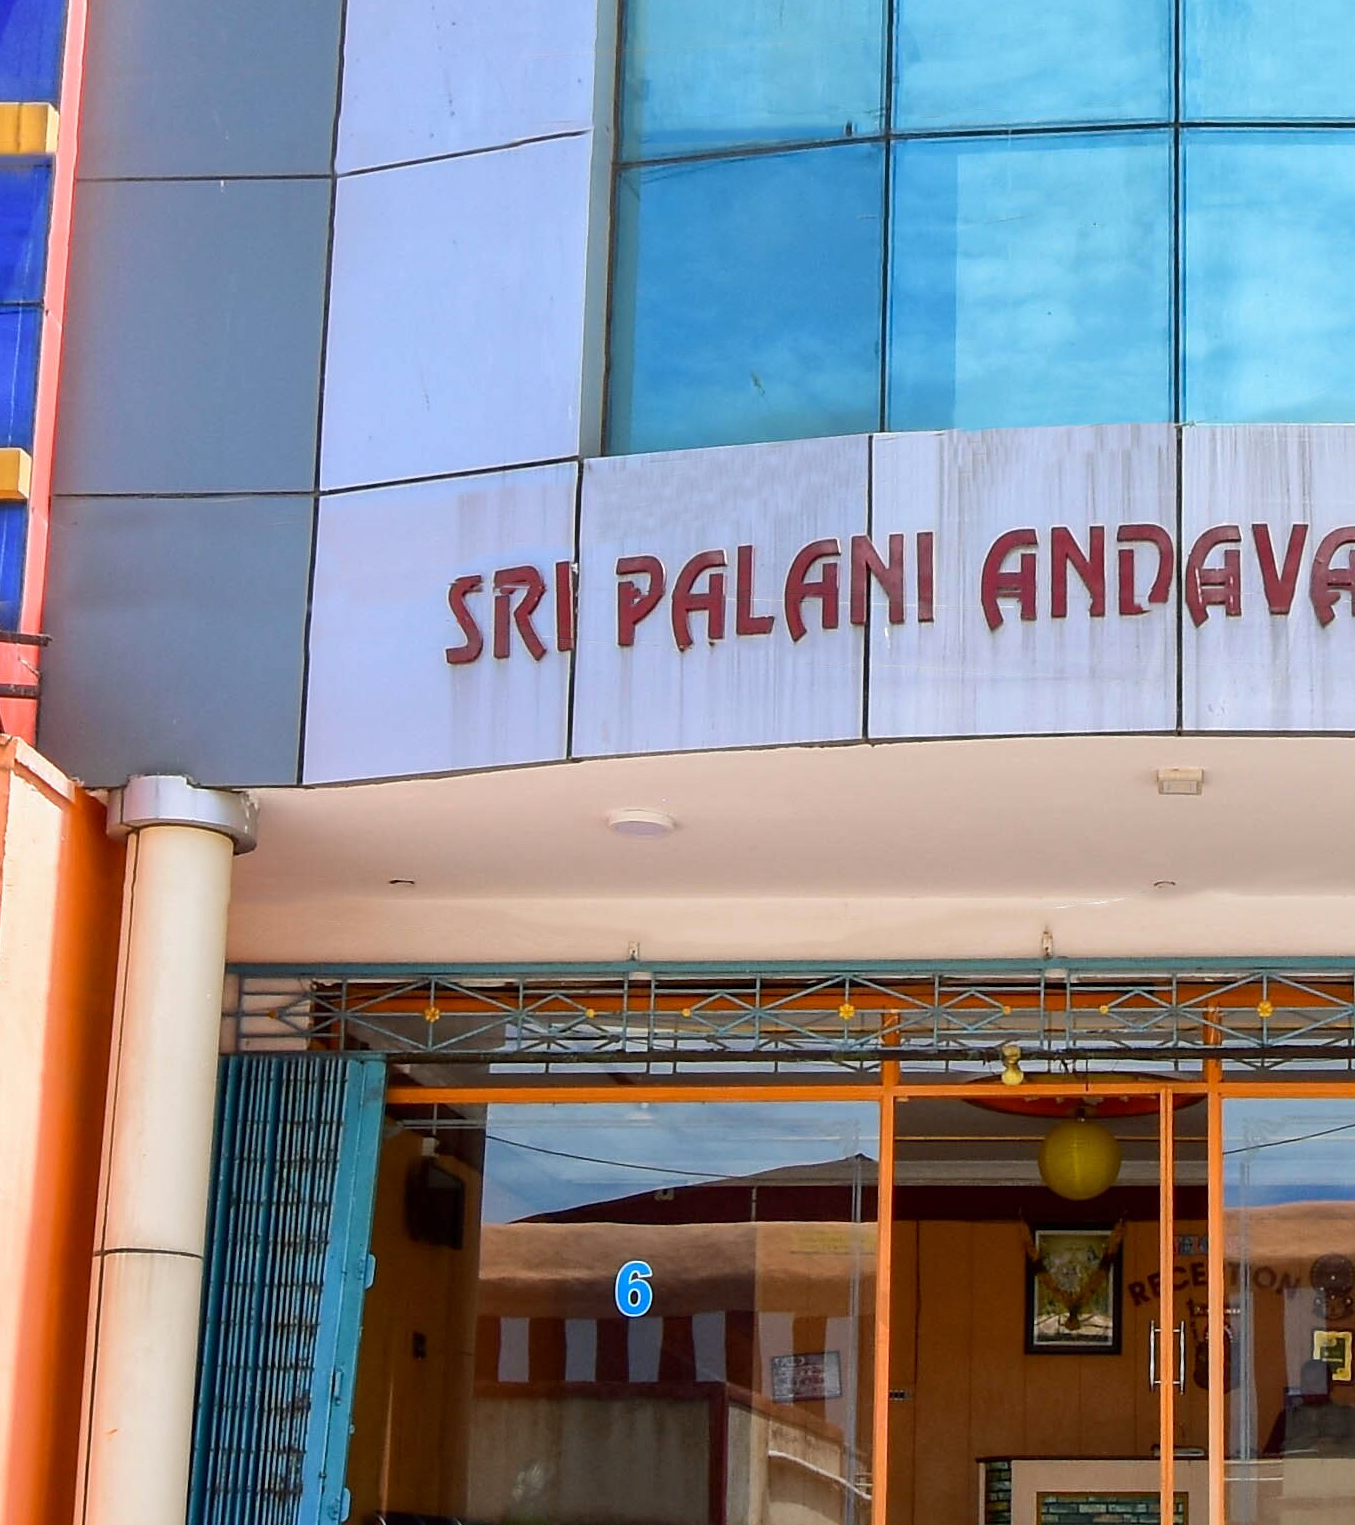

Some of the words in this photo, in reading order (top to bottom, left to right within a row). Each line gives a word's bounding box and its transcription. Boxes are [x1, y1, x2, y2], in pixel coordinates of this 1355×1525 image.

[445, 560, 576, 664] SRI
[615, 531, 934, 652] PALANI
[614, 1260, 654, 1317] 6
